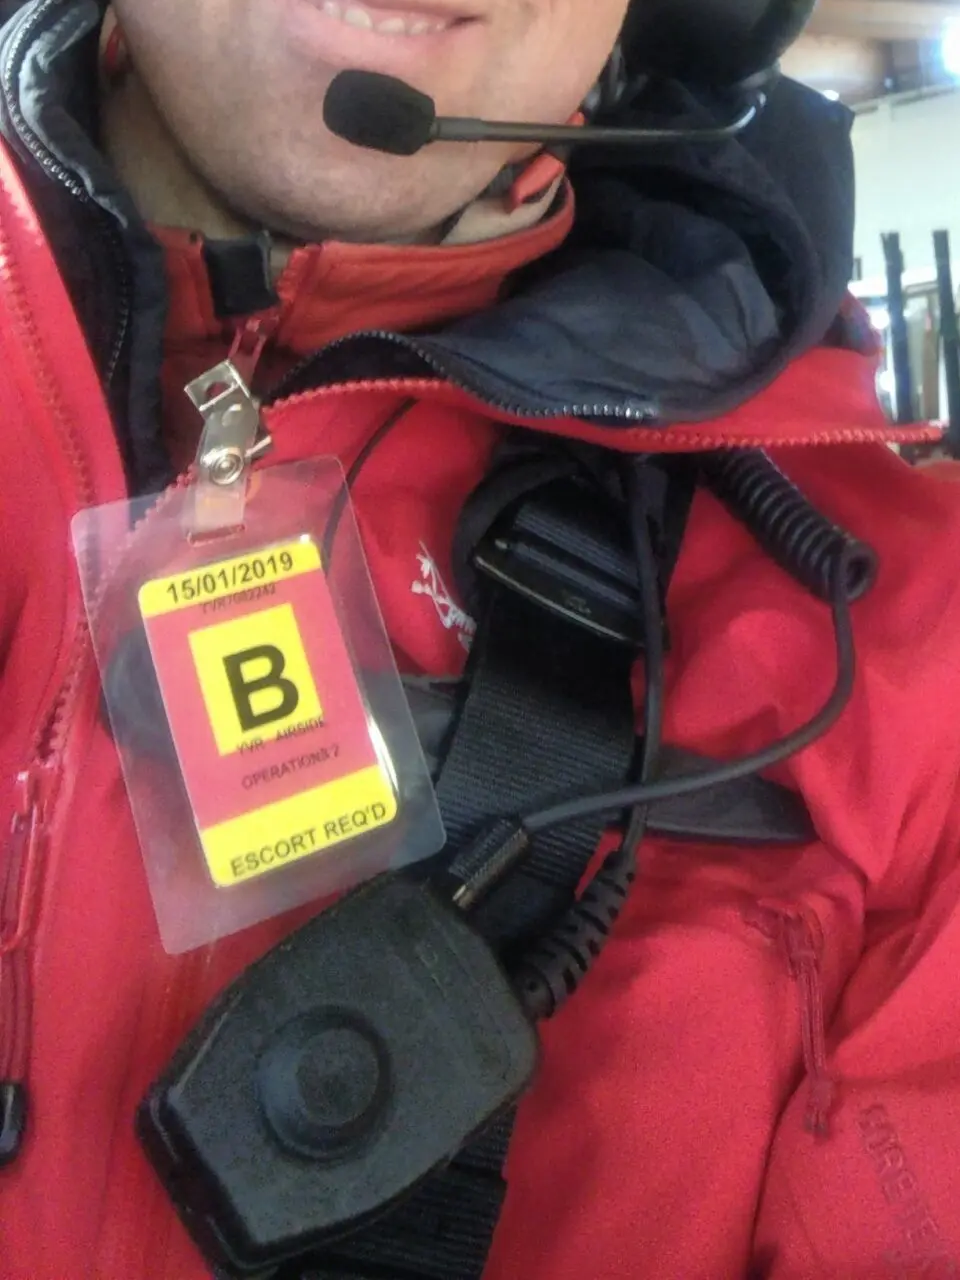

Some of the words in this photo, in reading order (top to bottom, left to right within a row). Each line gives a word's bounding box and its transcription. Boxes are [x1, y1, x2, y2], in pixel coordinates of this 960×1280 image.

[167, 552, 293, 603] 15/01/2019
[223, 644, 299, 733] B
[230, 828, 316, 877] ESCORT
[323, 802, 386, 840] REQ'D
